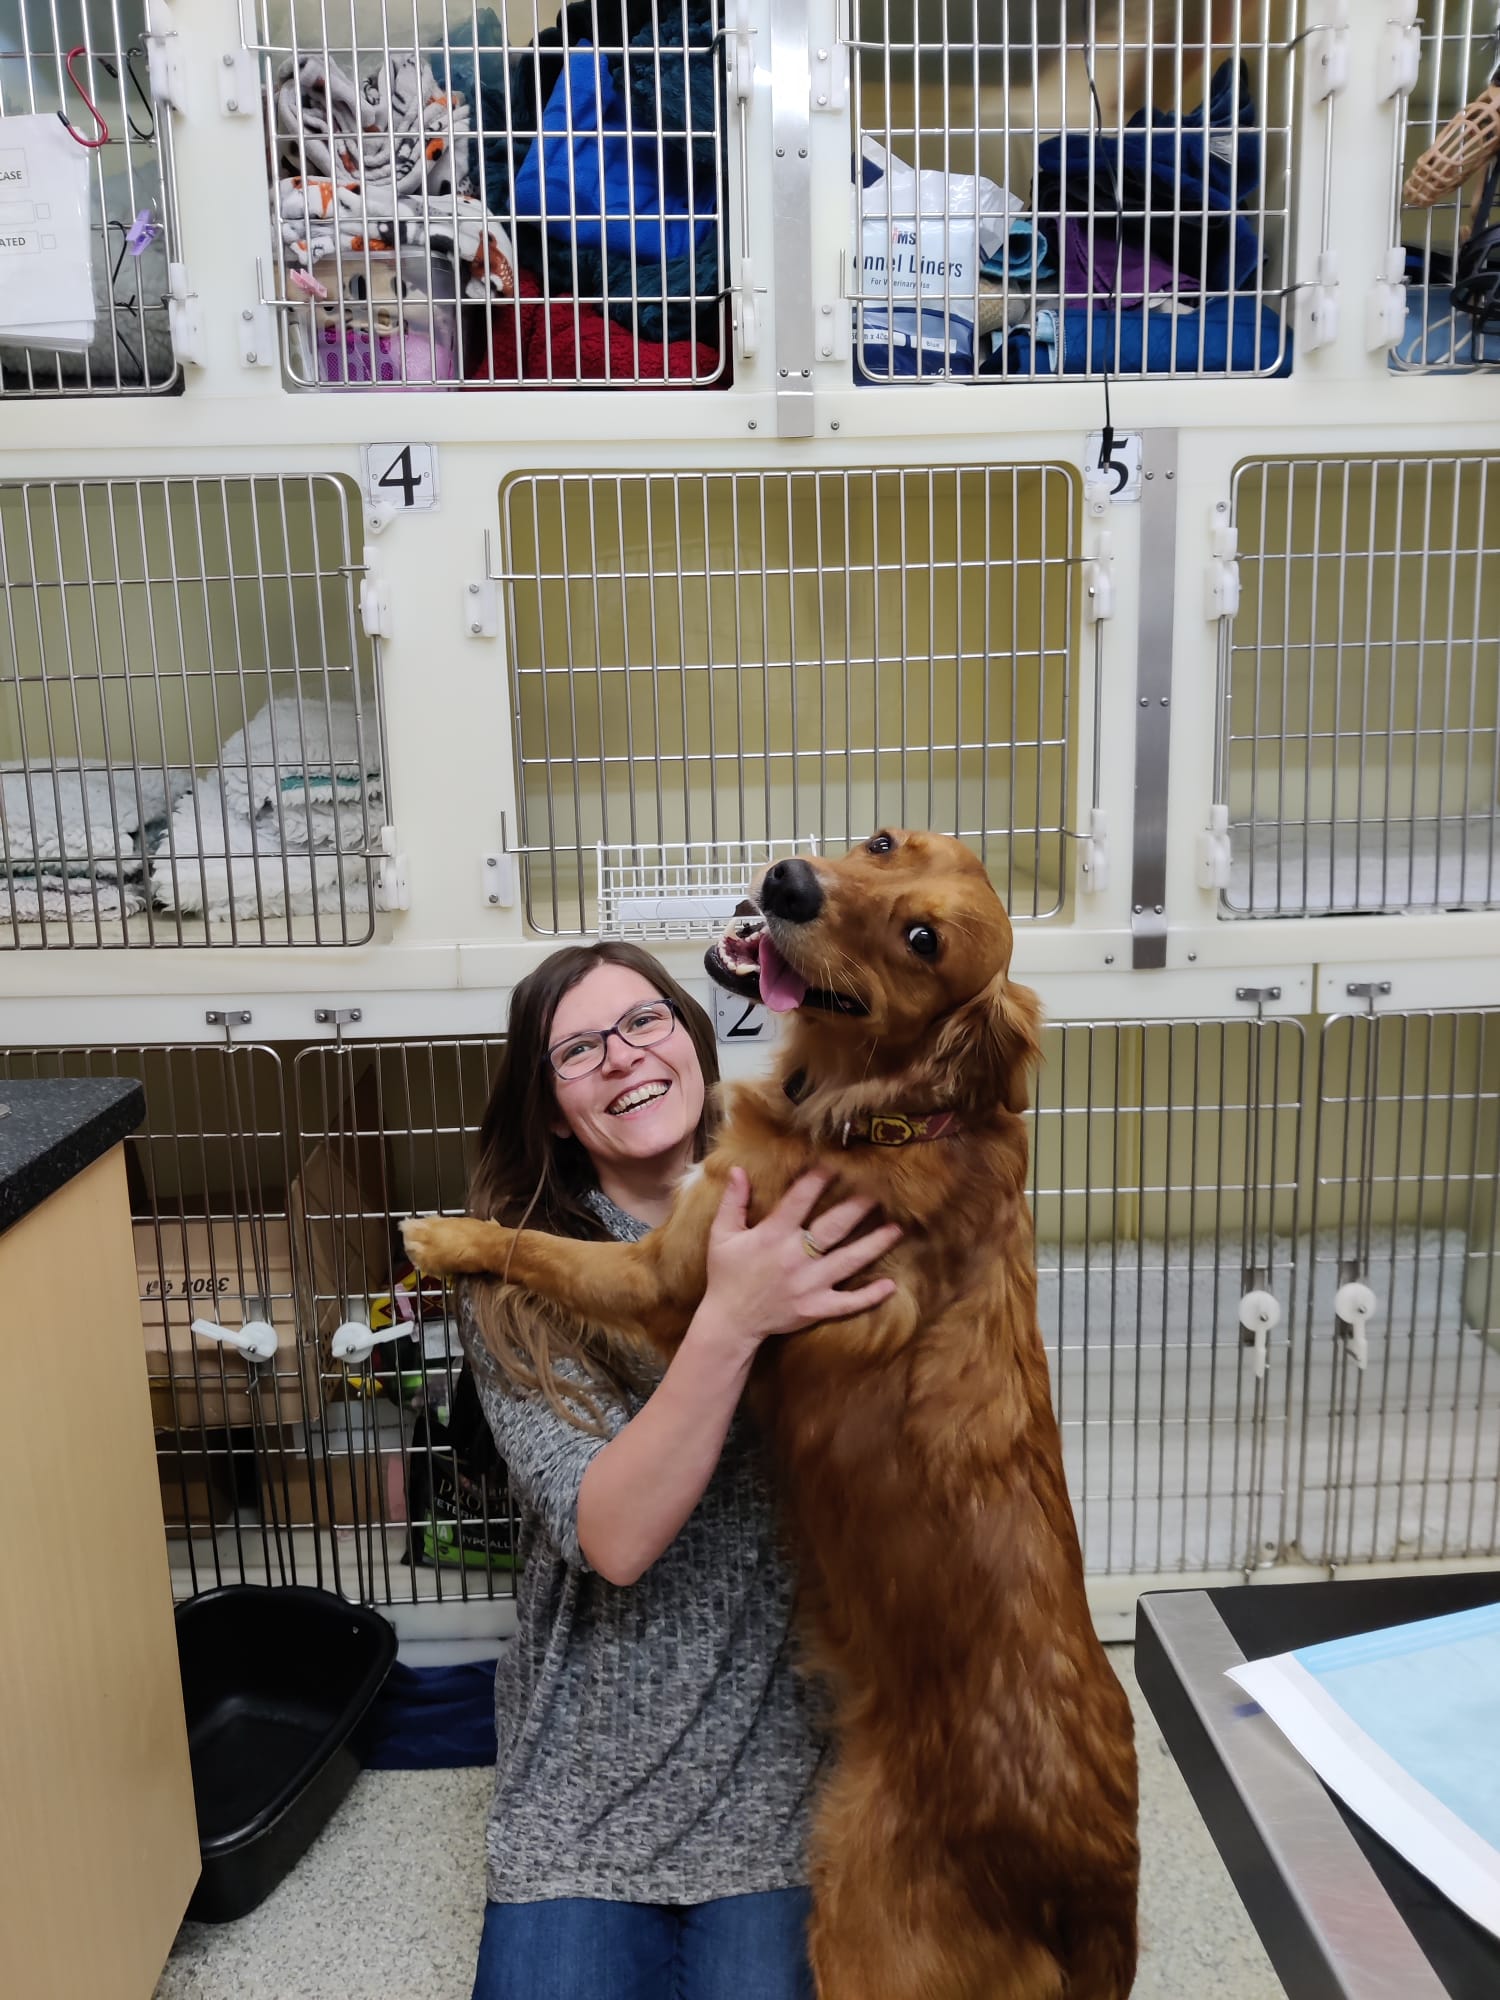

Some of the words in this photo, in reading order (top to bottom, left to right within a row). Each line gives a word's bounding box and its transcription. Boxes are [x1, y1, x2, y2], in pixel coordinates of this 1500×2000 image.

[870, 277, 882, 286] For
[883, 278, 917, 290] Verinary
[909, 255, 963, 278] Liners
[378, 444, 421, 507] 4
[1097, 438, 1128, 495] 5
[727, 995, 764, 1038] 2
